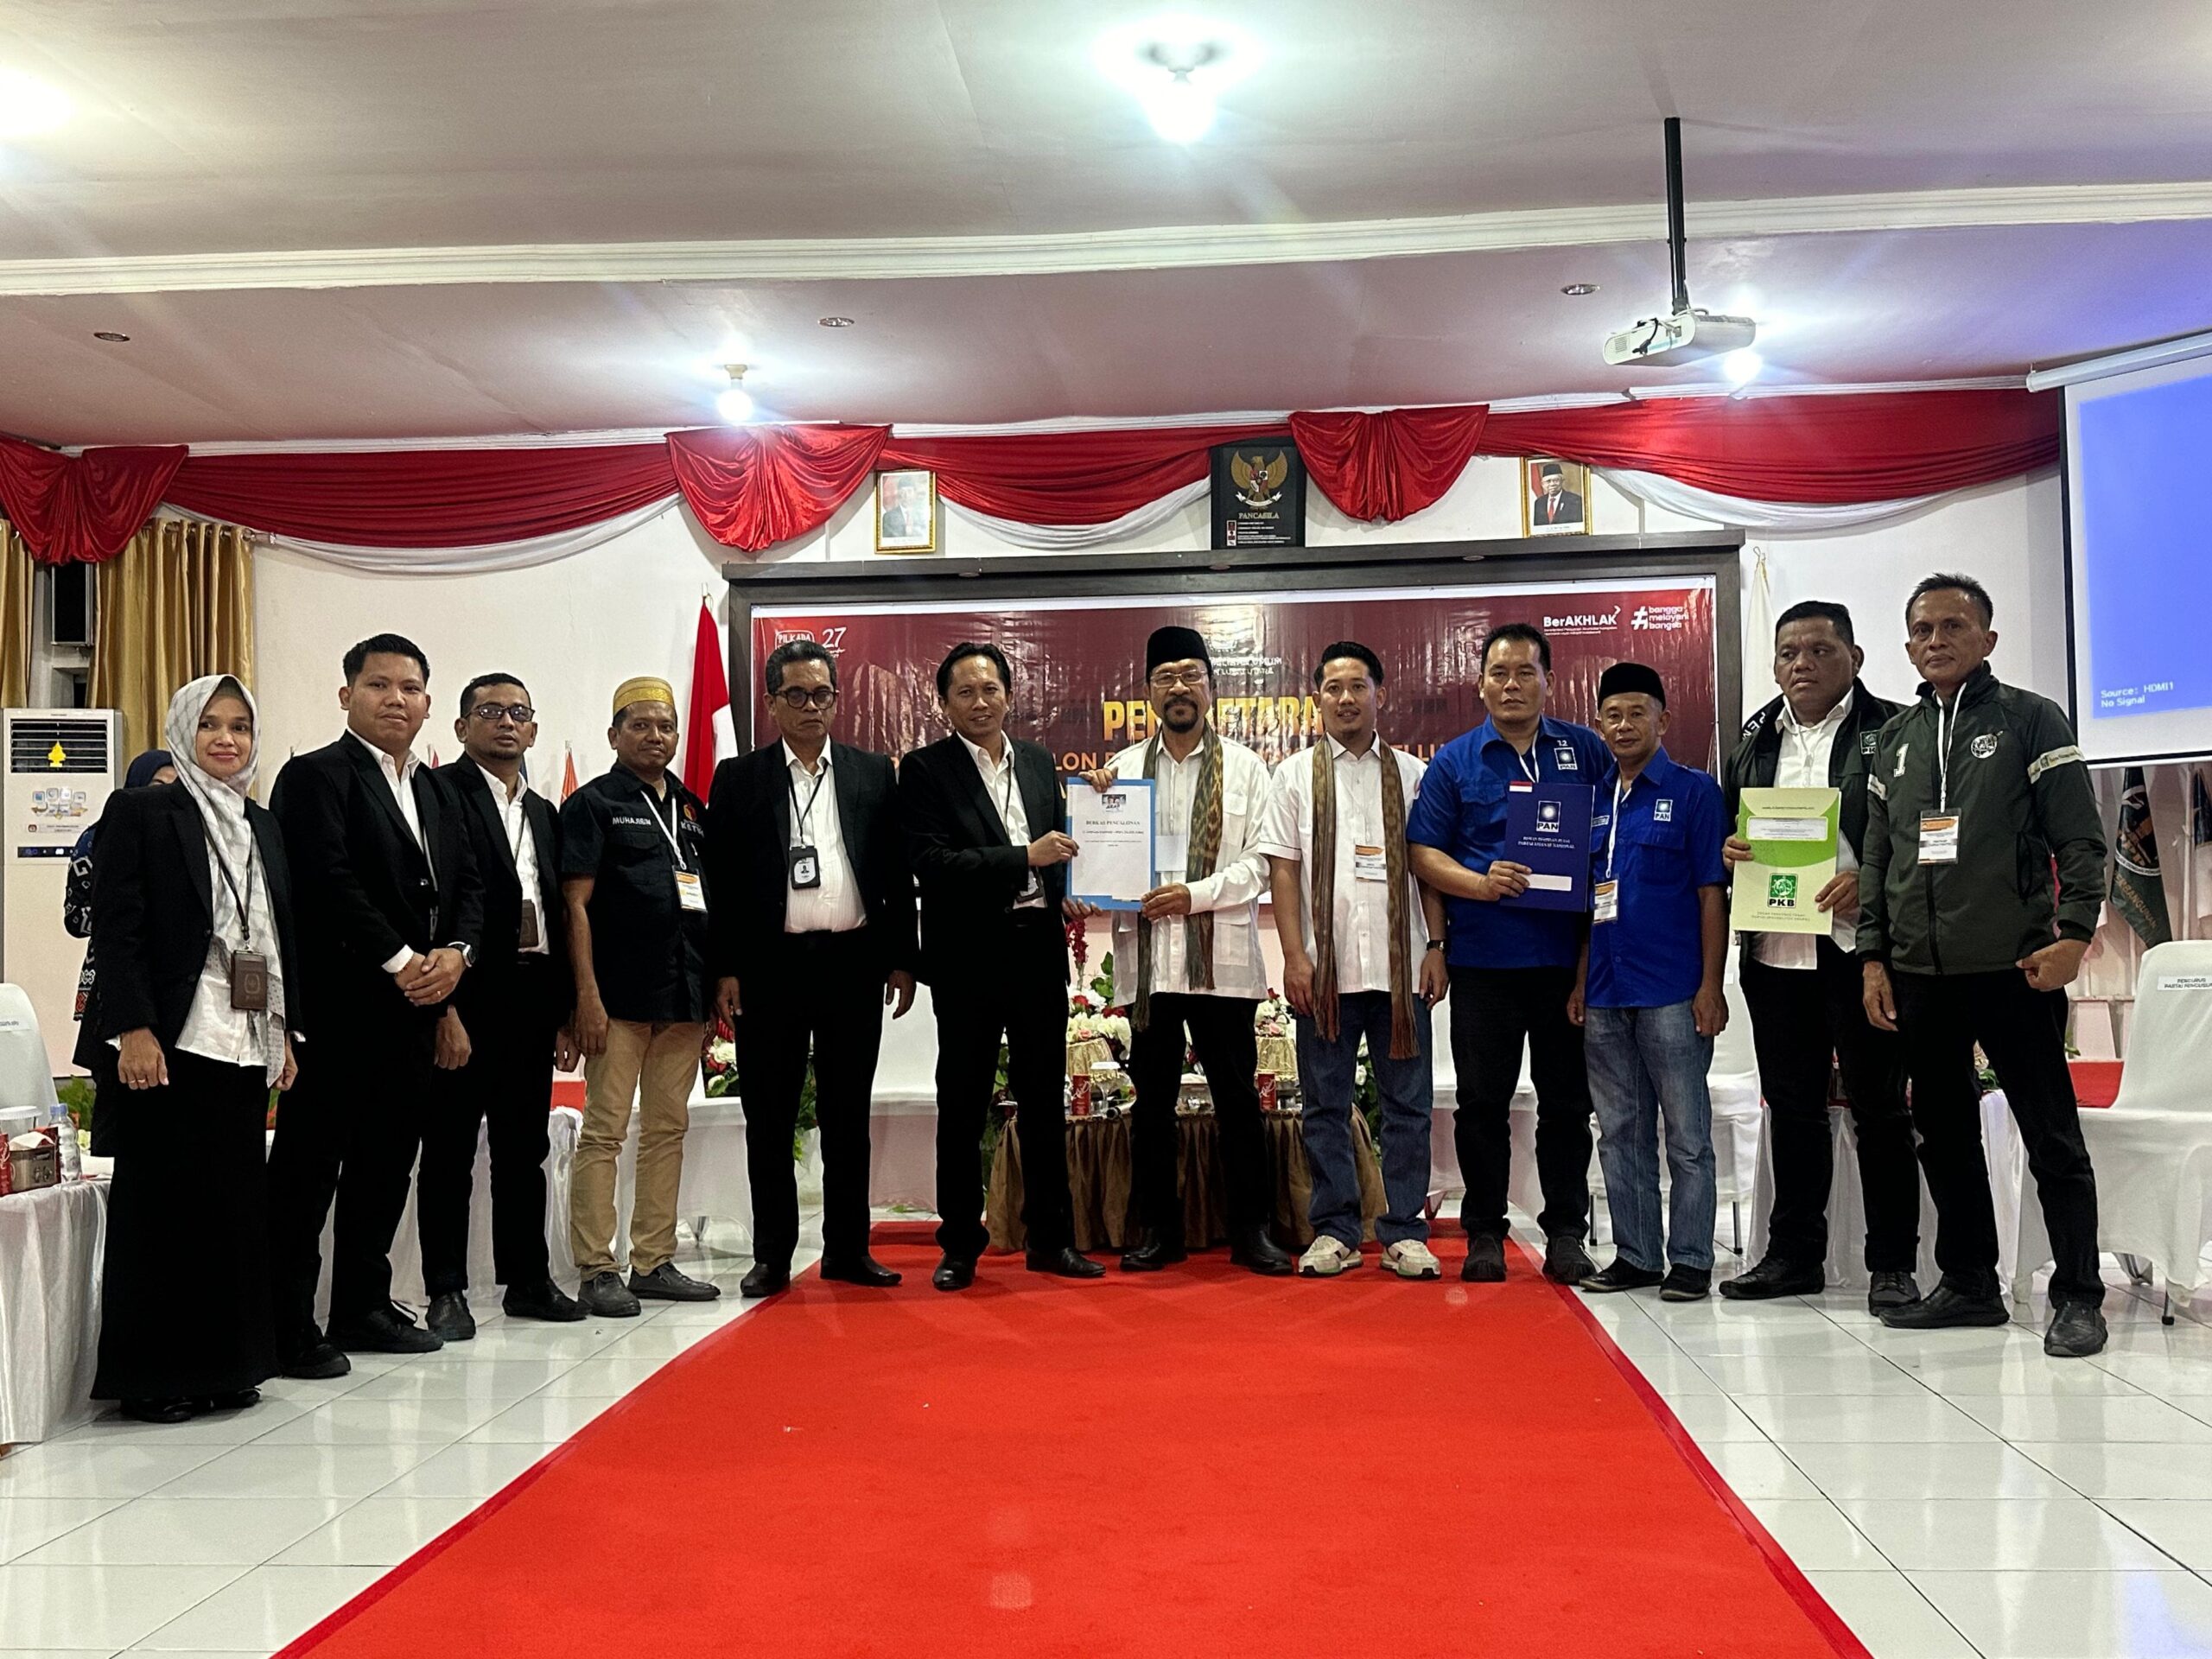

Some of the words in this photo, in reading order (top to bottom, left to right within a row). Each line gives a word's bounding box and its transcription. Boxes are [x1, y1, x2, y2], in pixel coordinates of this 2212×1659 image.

[1649, 606, 1683, 614] bangga
[1543, 612, 1618, 627] BerAKHLAK
[779, 633, 811, 644] PILKADA
[823, 626, 847, 648] 27
[2101, 688, 2139, 698] Source:
[2144, 681, 2174, 693] HDMI1
[2116, 695, 2145, 707] Signal
[1052, 752, 1097, 771] LON
[1894, 743, 1909, 777] 1
